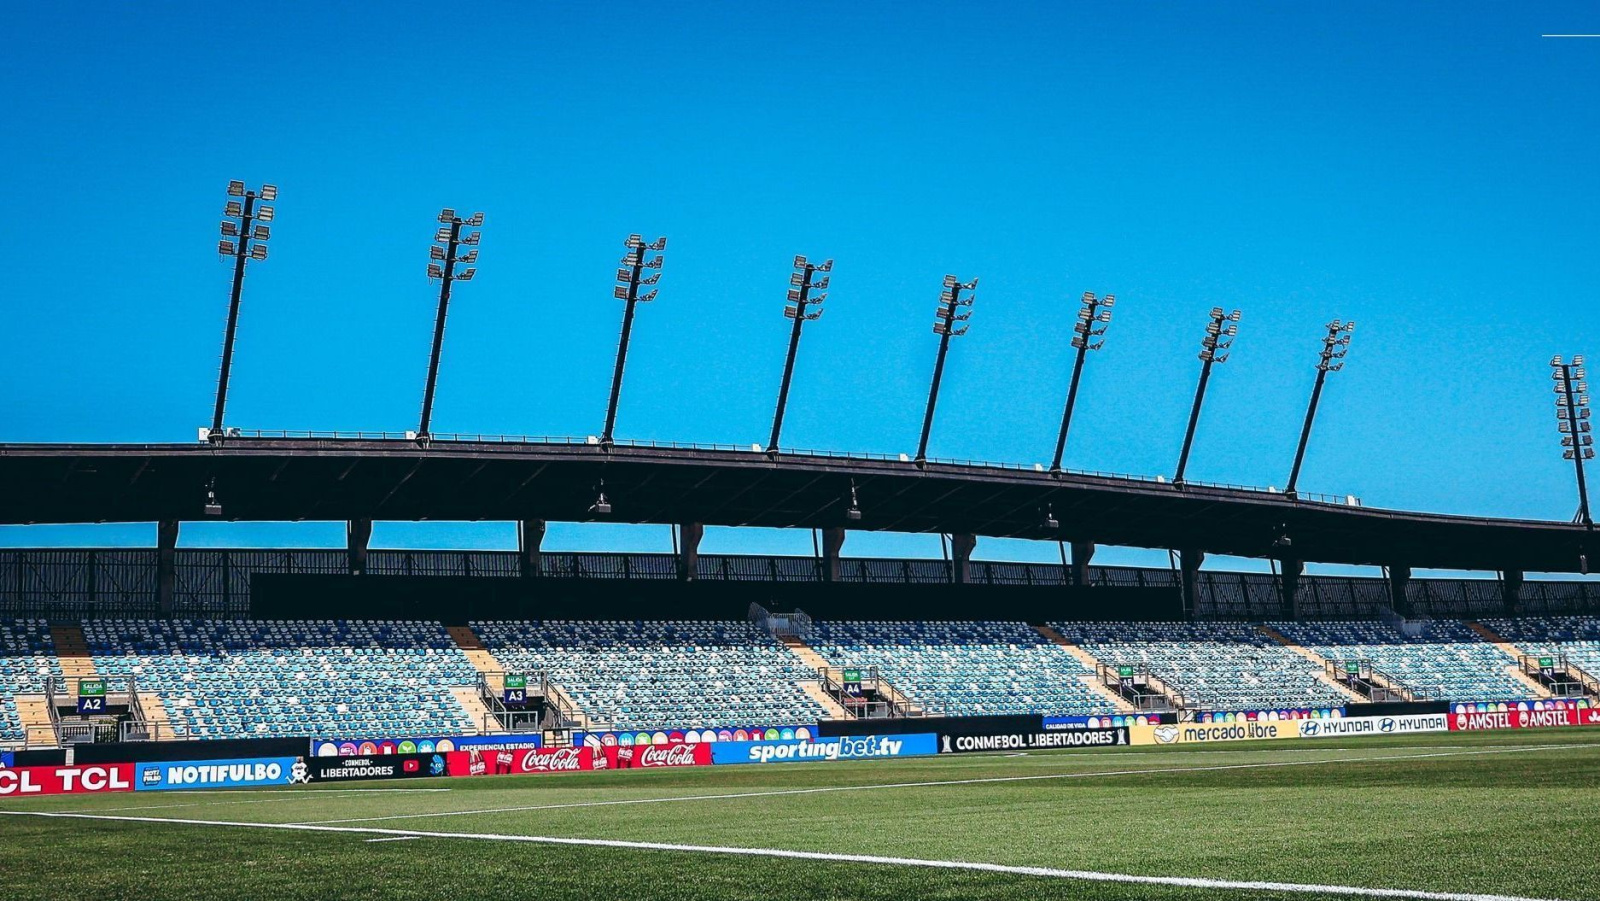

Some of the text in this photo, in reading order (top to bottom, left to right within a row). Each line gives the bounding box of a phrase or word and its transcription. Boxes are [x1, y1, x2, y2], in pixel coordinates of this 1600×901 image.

[508, 691, 523, 701] A3
[83, 699, 101, 710] A2
[1399, 717, 1446, 730] HYUNDAI
[1468, 712, 1511, 729] AMSTEL
[1529, 710, 1570, 726] AMSTEL
[1184, 722, 1277, 741] mercado libre
[1323, 720, 1374, 733] HYUNDAI
[956, 730, 1113, 750] CONMEBOL LIBERTADORES
[749, 735, 902, 762] sportingbet.tv
[56, 767, 129, 791] TCL
[168, 763, 281, 784] NOTIFULBO
[320, 766, 394, 778] LIBERTADORES
